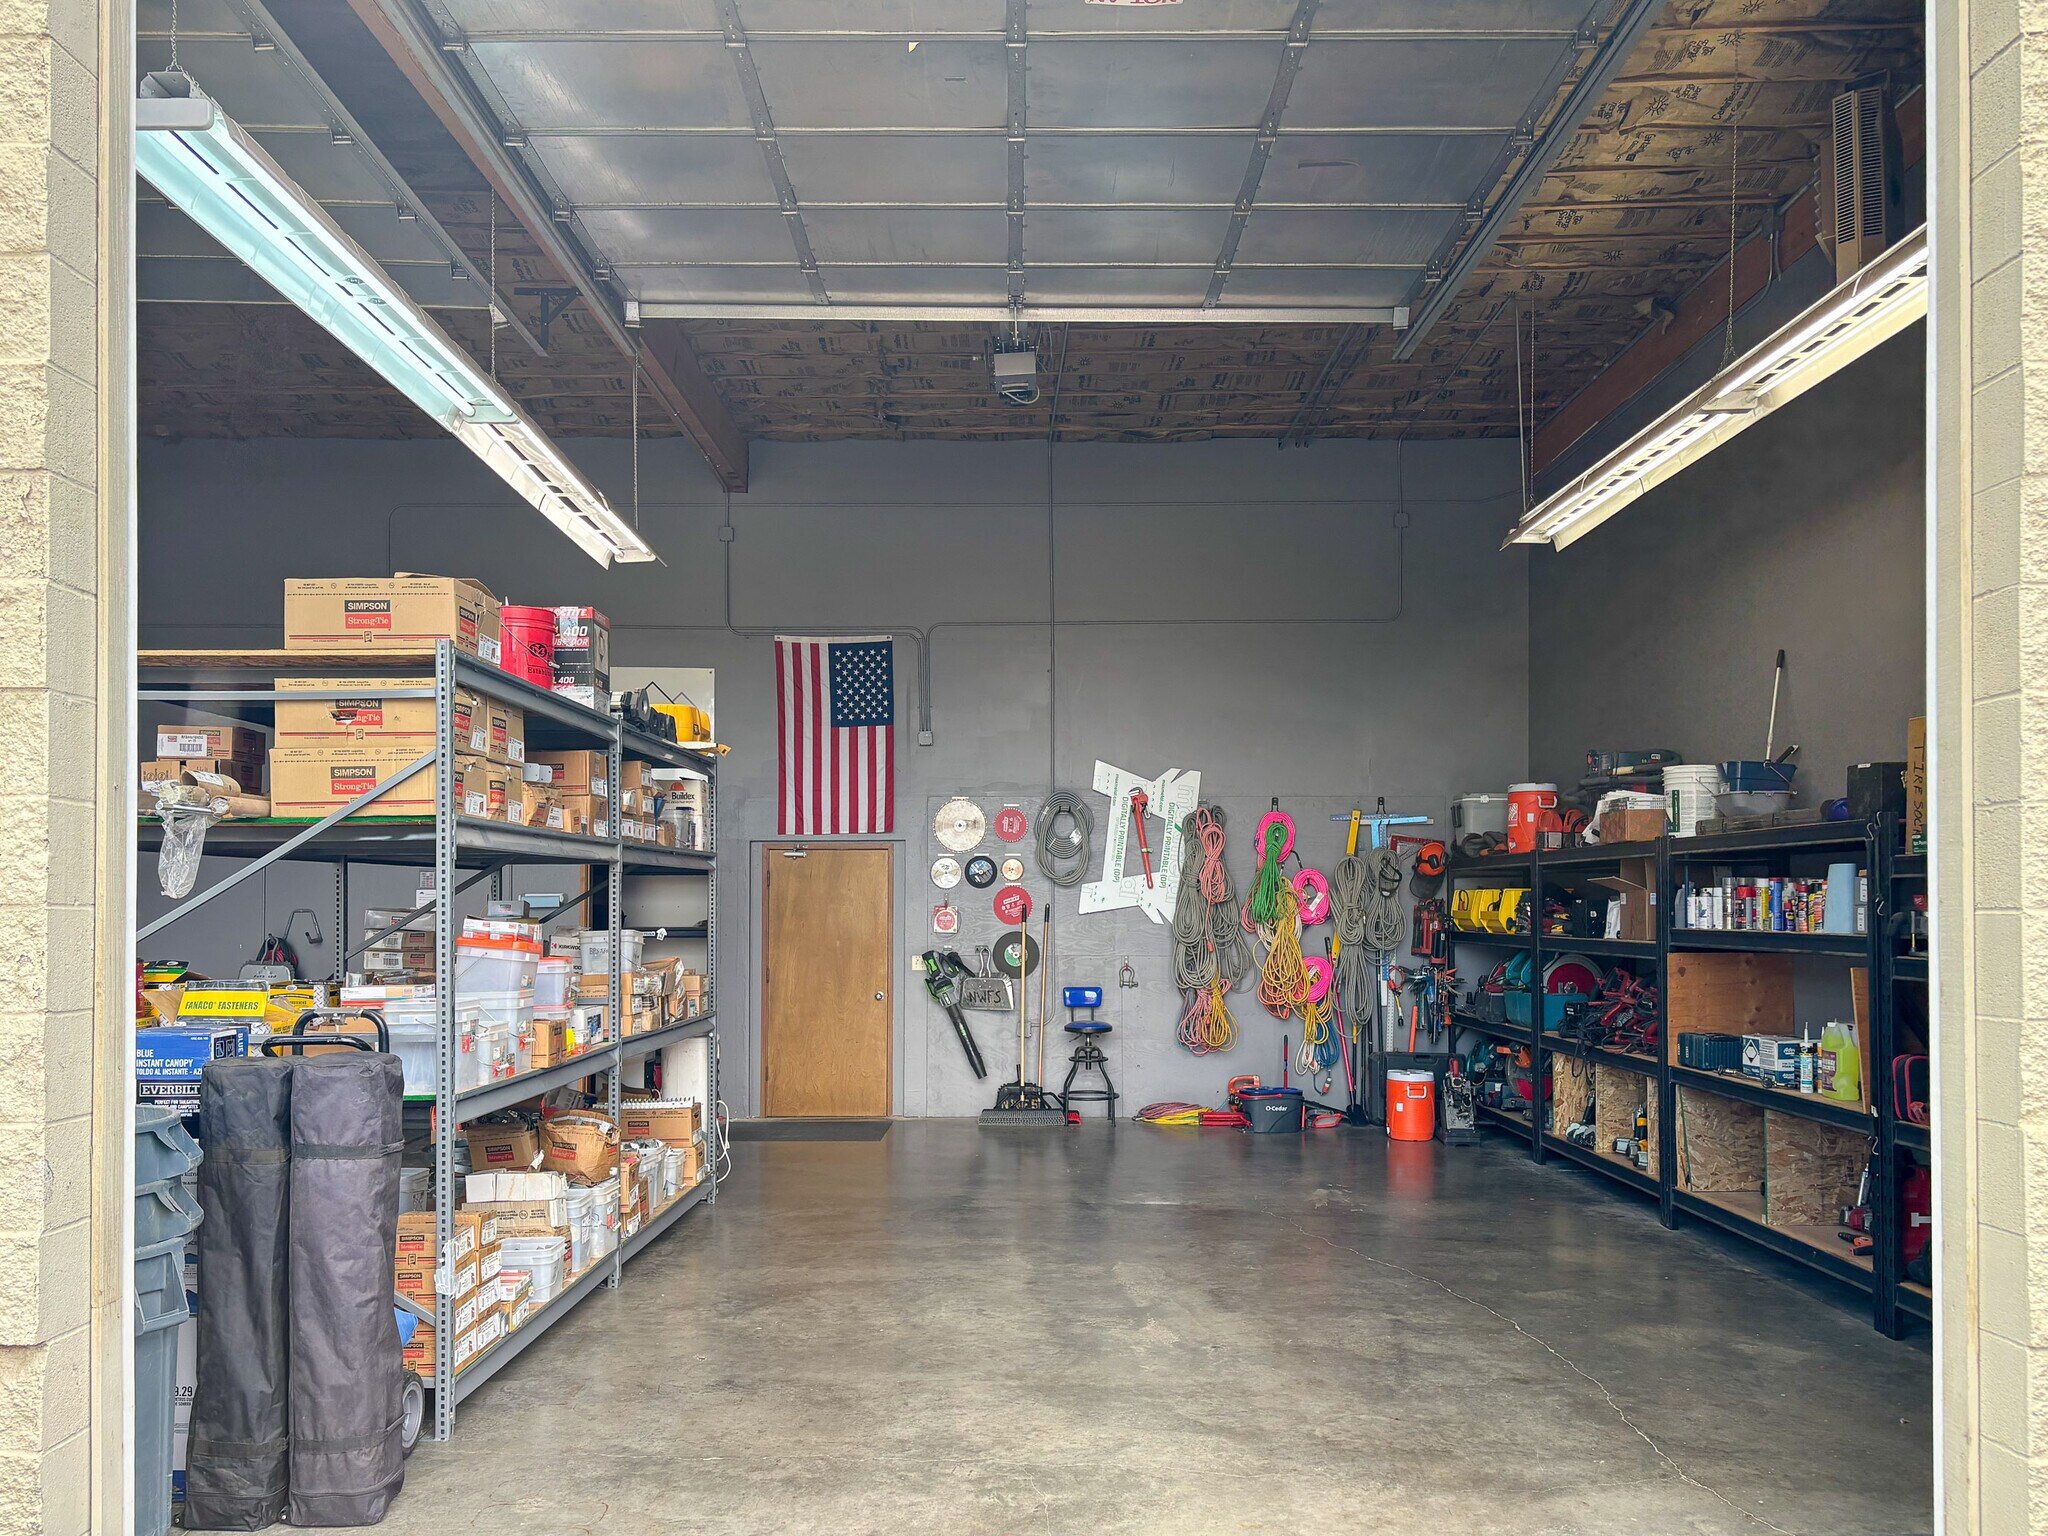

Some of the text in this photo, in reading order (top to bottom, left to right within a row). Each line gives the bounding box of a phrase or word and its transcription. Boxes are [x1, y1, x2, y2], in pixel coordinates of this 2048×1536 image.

[348, 602, 388, 611] SIMPSON
[563, 625, 588, 637] 400
[558, 676, 575, 684] 400
[338, 699, 379, 708] SIMPSON
[333, 768, 373, 777] SIMPSON
[671, 792, 695, 800] Buildex
[1118, 796, 1129, 830] DIGITALLY
[1114, 830, 1126, 868] PRINTABLE
[1159, 802, 1176, 889] DIGITALLY PRINTABLE (DP)
[1112, 868, 1123, 883] (DP)
[969, 990, 1001, 1003] NWFS
[217, 1001, 259, 1010] FASTENERS
[136, 1049, 154, 1058] BLUE
[136, 1059, 194, 1068] INSTANT CANOPY
[141, 1085, 201, 1095] EVERBILT
[487, 1145, 512, 1153] SIMPSON
